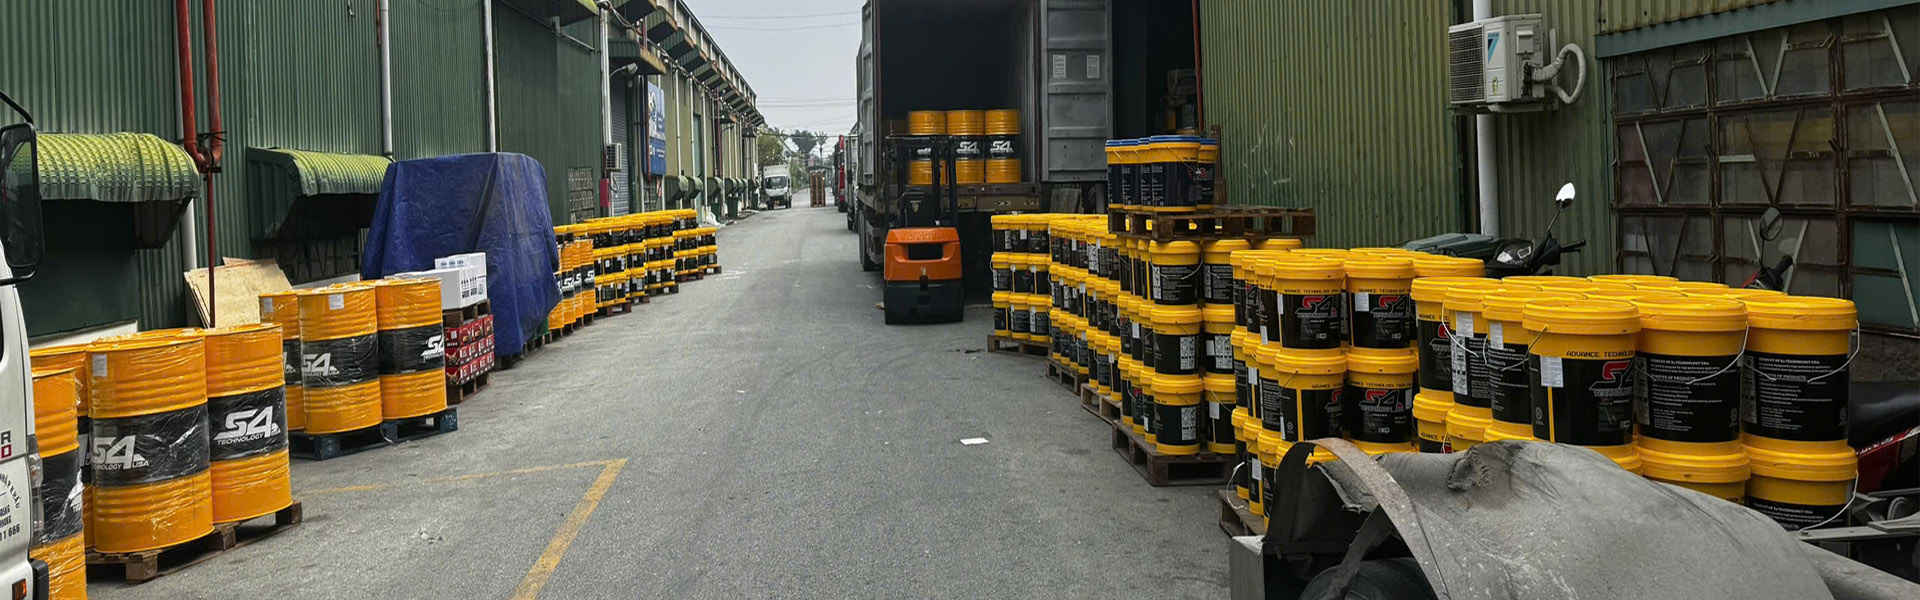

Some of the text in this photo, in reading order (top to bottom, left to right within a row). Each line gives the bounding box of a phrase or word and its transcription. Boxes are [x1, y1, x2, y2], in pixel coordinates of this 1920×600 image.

[989, 140, 1011, 153] S4
[1566, 350, 1600, 358] ADVANCE
[213, 405, 273, 440] S4
[217, 433, 264, 446] TECHNOLOGY
[91, 435, 135, 469] S4
[132, 460, 149, 468] USA
